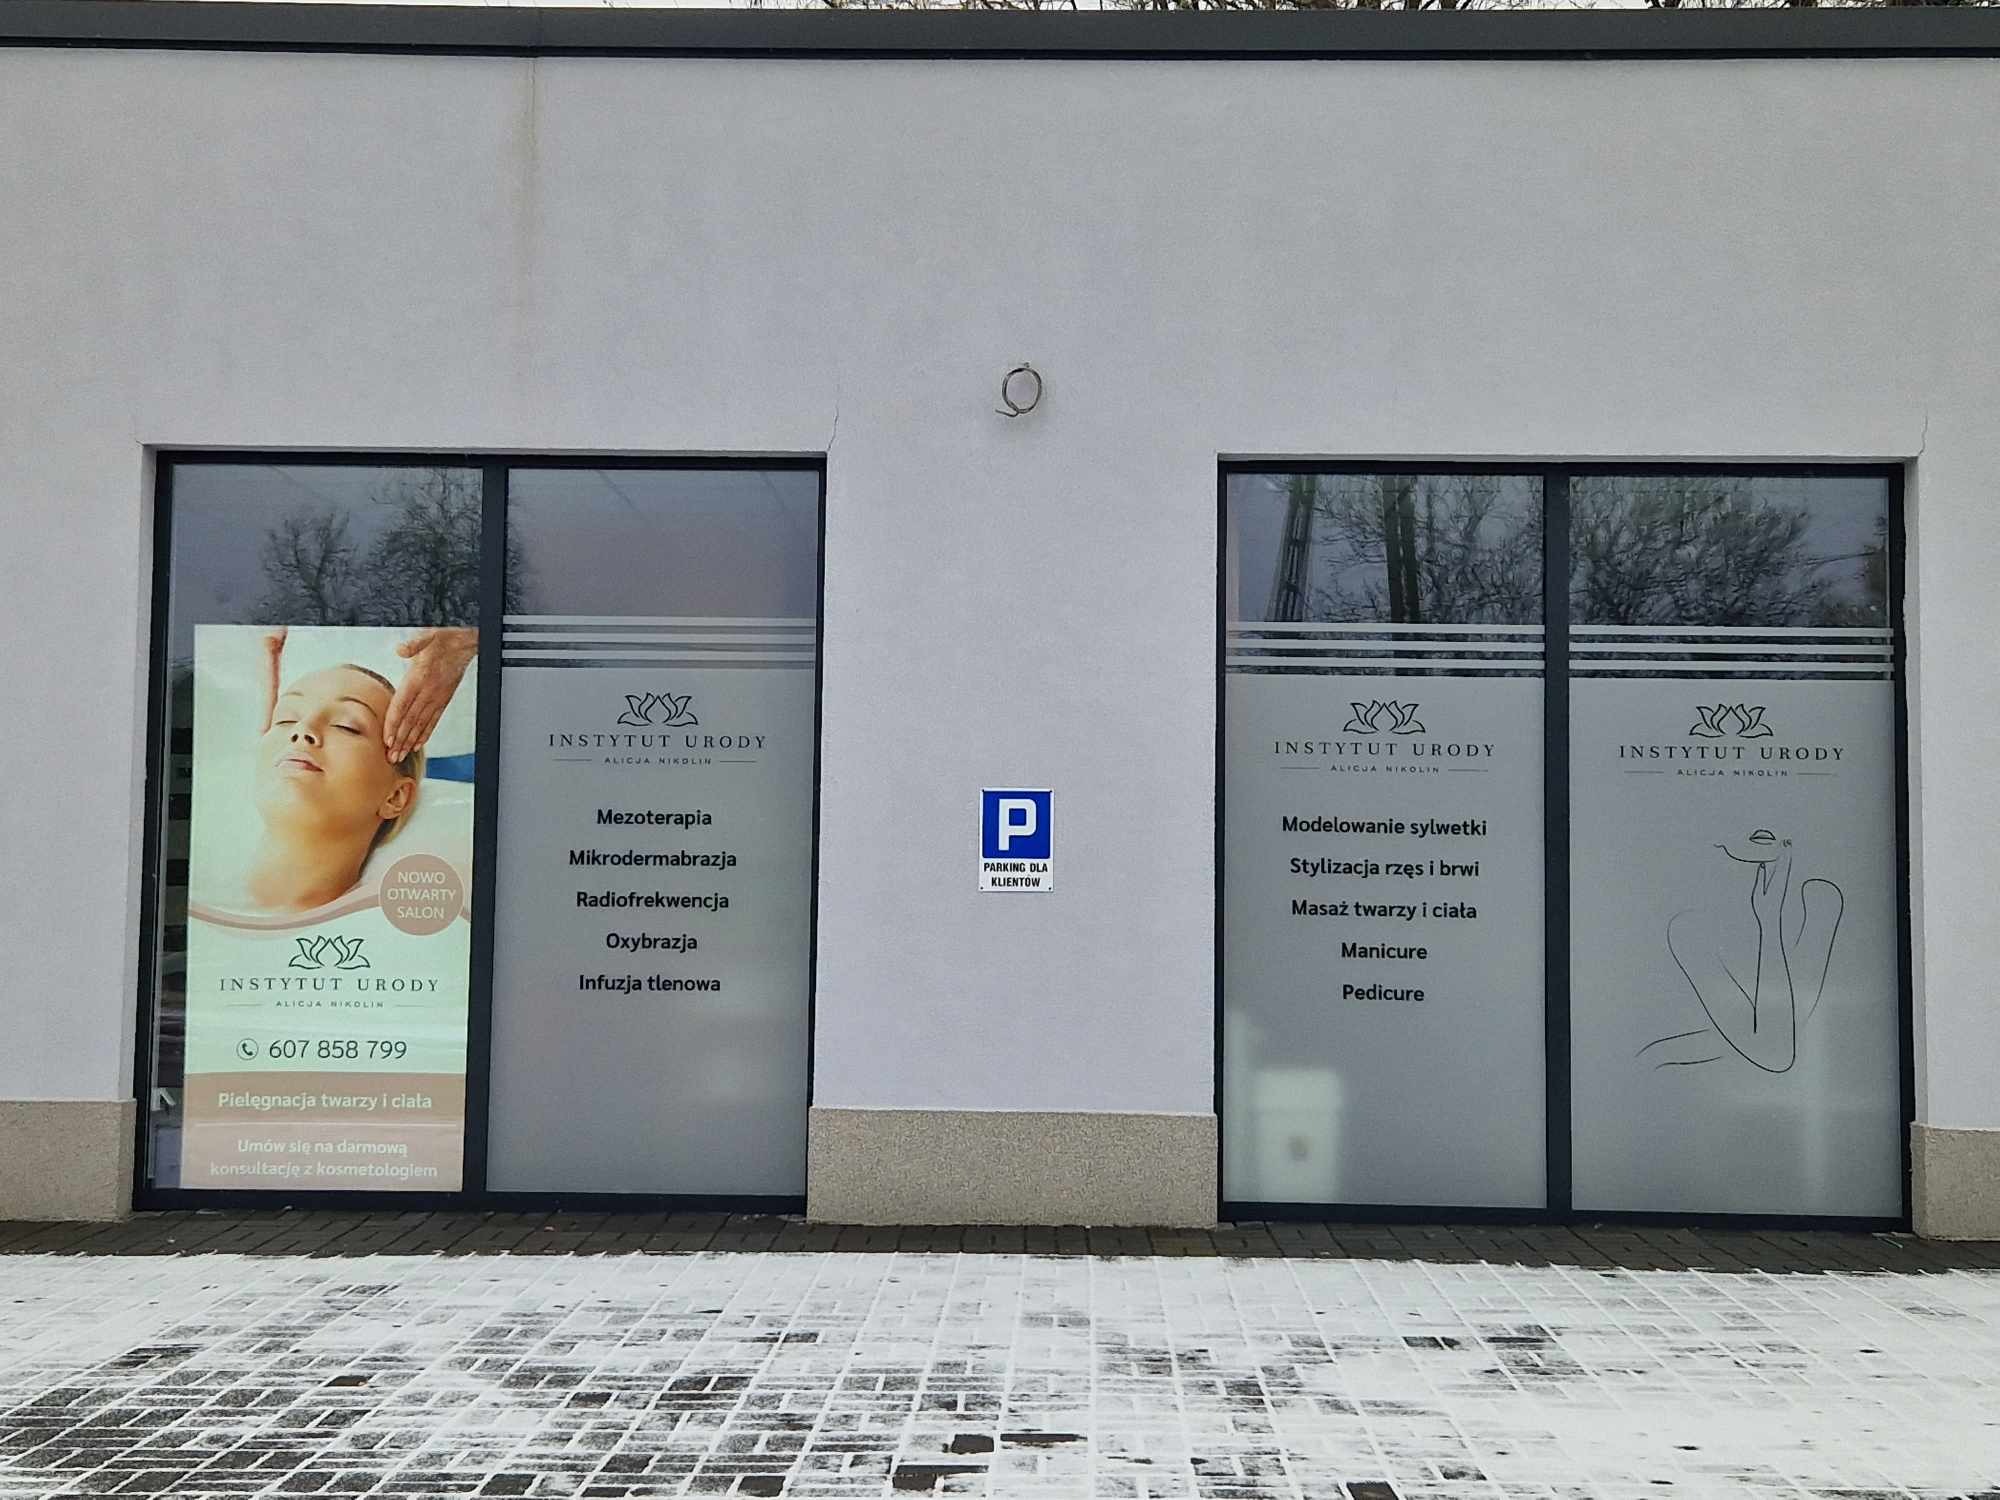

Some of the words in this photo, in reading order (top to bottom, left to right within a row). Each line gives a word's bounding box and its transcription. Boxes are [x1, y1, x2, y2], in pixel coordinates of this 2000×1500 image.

[548, 733, 671, 748] INSTYTUT
[684, 735, 768, 750] URODY
[1273, 741, 1398, 756] INSTYTUT
[1412, 743, 1496, 757] URODY
[604, 757, 651, 765] ALICJA
[658, 757, 712, 765] NIKOLIN
[1618, 745, 1747, 759] INSTYTUT
[1759, 746, 1846, 761] URODY
[1330, 764, 1378, 772] ALICJA
[1385, 765, 1441, 773] NIKOLIN
[1676, 768, 1726, 777] ALICJA
[1732, 768, 1789, 777] NIKOLIN
[596, 808, 713, 830] Mezoterapia
[998, 798, 1037, 851] P
[1281, 815, 1406, 834] Modelowanie
[1409, 819, 1488, 838] sylwetki
[568, 849, 738, 870] Mikrodermabrazja
[983, 862, 1026, 873] PARKING
[1029, 862, 1049, 873] DLA
[1289, 857, 1380, 878] Stylizacja
[1384, 864, 1424, 879] rzęs
[1428, 860, 1435, 876] i
[1439, 861, 1480, 877] brwi
[397, 871, 446, 884] NOWO
[991, 874, 1041, 887] KLIENTÓW
[386, 887, 457, 901] OTWARTY
[575, 891, 730, 911] Radiofrekwencja
[396, 906, 445, 919] SALON
[1291, 899, 1349, 917] Masaż
[1353, 901, 1418, 921] twarzy
[1421, 902, 1428, 918] i
[1431, 902, 1478, 919] ciała
[605, 932, 699, 953] Oxybrazja
[1340, 942, 1428, 960] Manicure
[219, 977, 343, 991] INSTYTUT
[357, 979, 440, 992] URODY
[578, 974, 643, 995] Infuzja
[646, 974, 722, 992] tlenowa
[1341, 983, 1426, 1001] Pedicure
[275, 1000, 323, 1008] ALICJA
[330, 1000, 385, 1009] NIKOLIN
[269, 1039, 310, 1059] 607
[317, 1039, 359, 1059] 858
[366, 1039, 408, 1059] 799
[217, 1092, 317, 1111] Pielęgnacja
[321, 1094, 378, 1111] twarzy
[381, 1093, 388, 1108] i
[391, 1093, 433, 1109] ciała
[237, 1139, 286, 1153] Umów
[288, 1139, 311, 1155] się
[314, 1143, 333, 1154] na
[336, 1140, 408, 1157] darmową
[209, 1160, 300, 1178] konsultację
[303, 1166, 313, 1176] z
[316, 1161, 438, 1180] kosmetologiem
